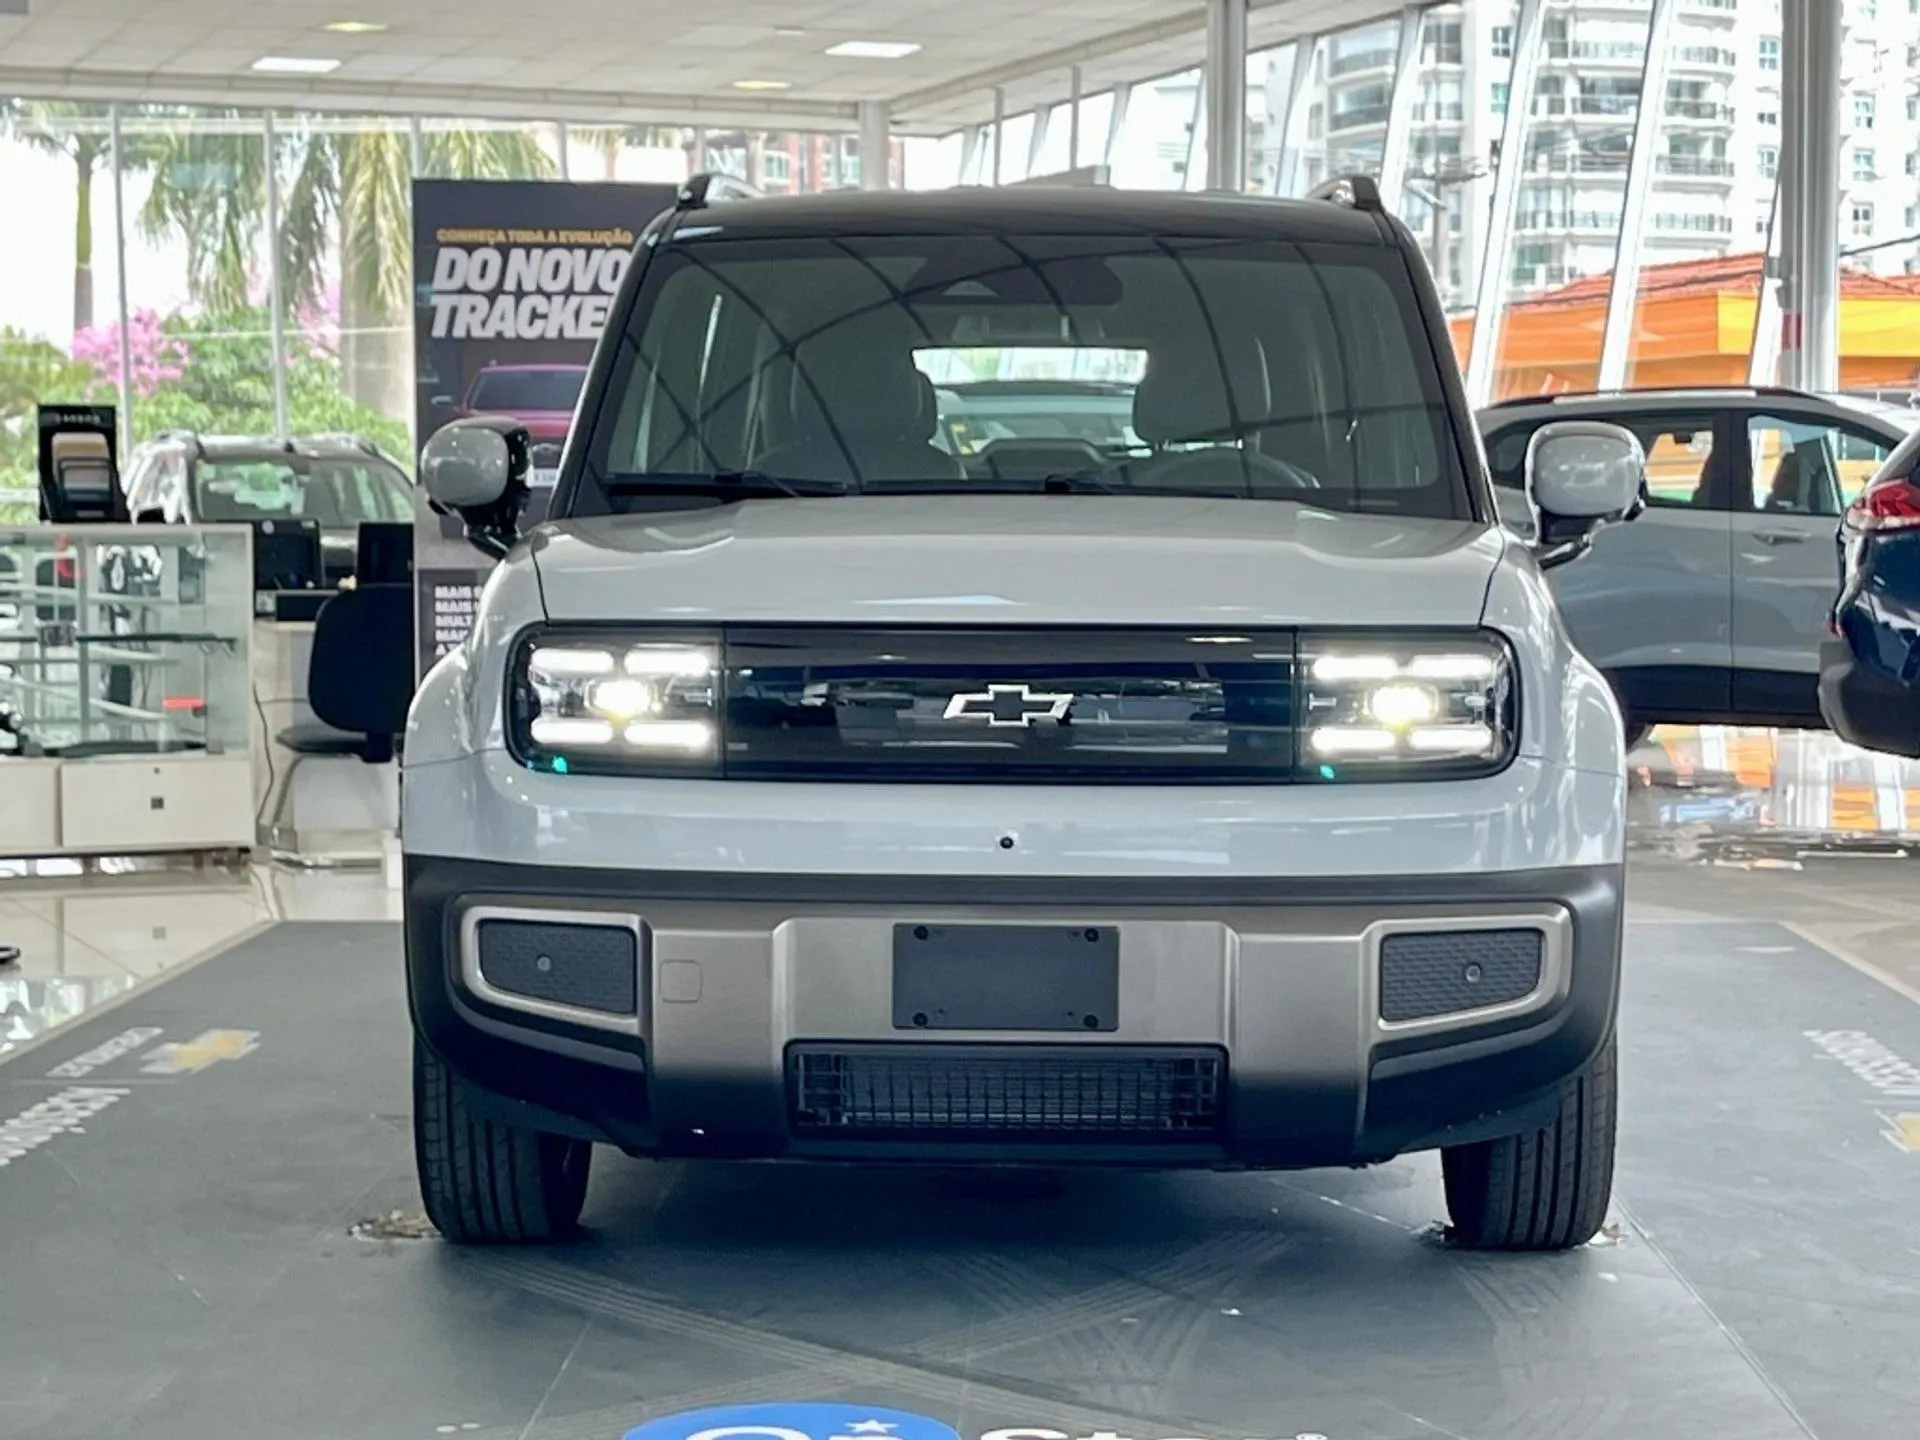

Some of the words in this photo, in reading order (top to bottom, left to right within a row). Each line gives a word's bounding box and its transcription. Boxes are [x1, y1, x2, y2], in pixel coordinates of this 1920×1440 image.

[433, 247, 502, 293] DO
[503, 247, 632, 293] NOVO
[430, 294, 617, 339] TRACKE
